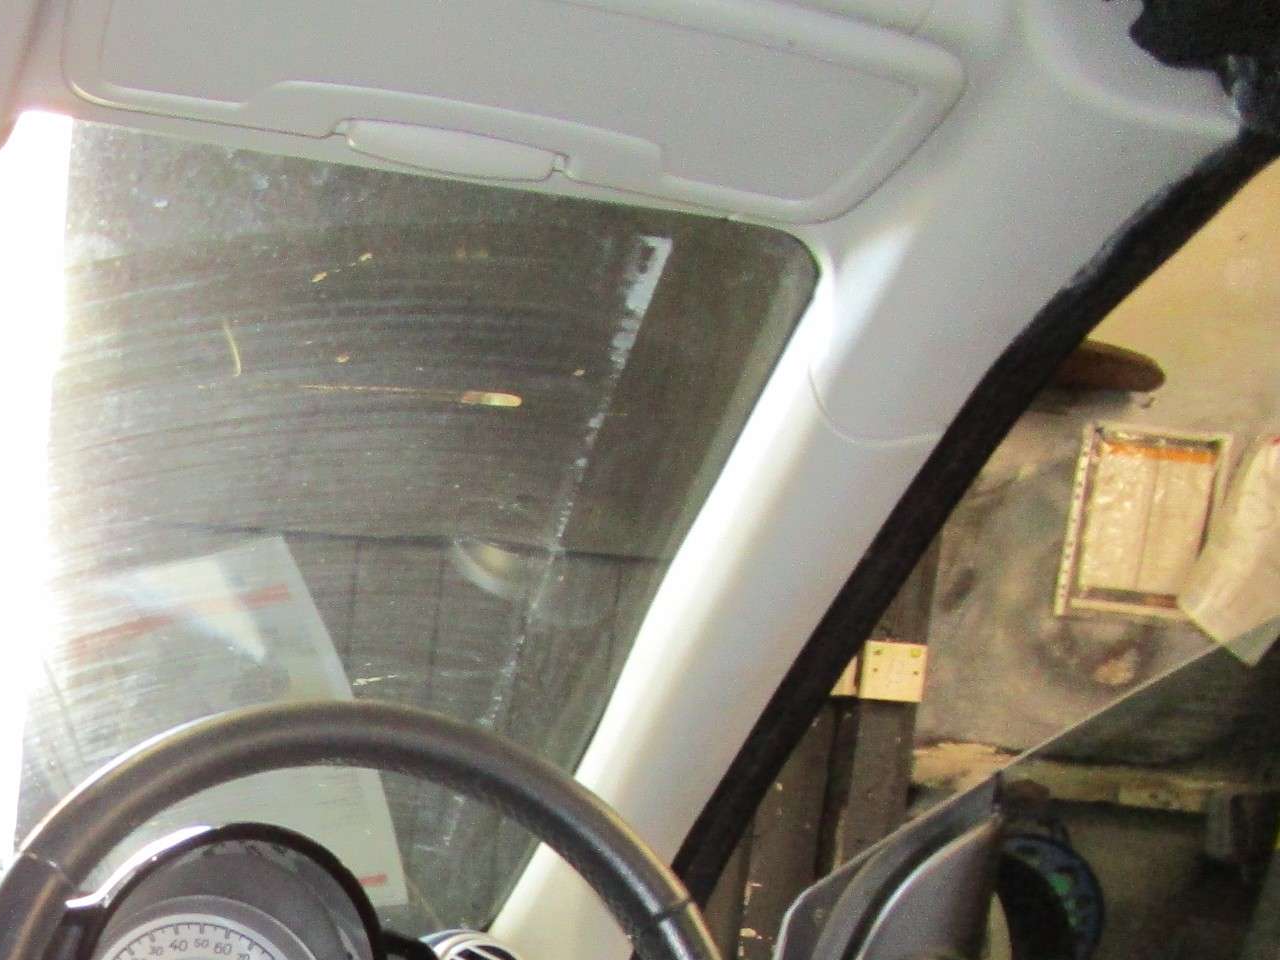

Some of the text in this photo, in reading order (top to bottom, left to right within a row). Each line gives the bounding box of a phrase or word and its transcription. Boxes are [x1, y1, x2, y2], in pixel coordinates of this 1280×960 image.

[169, 939, 188, 952] 40
[194, 938, 209, 949] 50
[214, 943, 232, 955] 60
